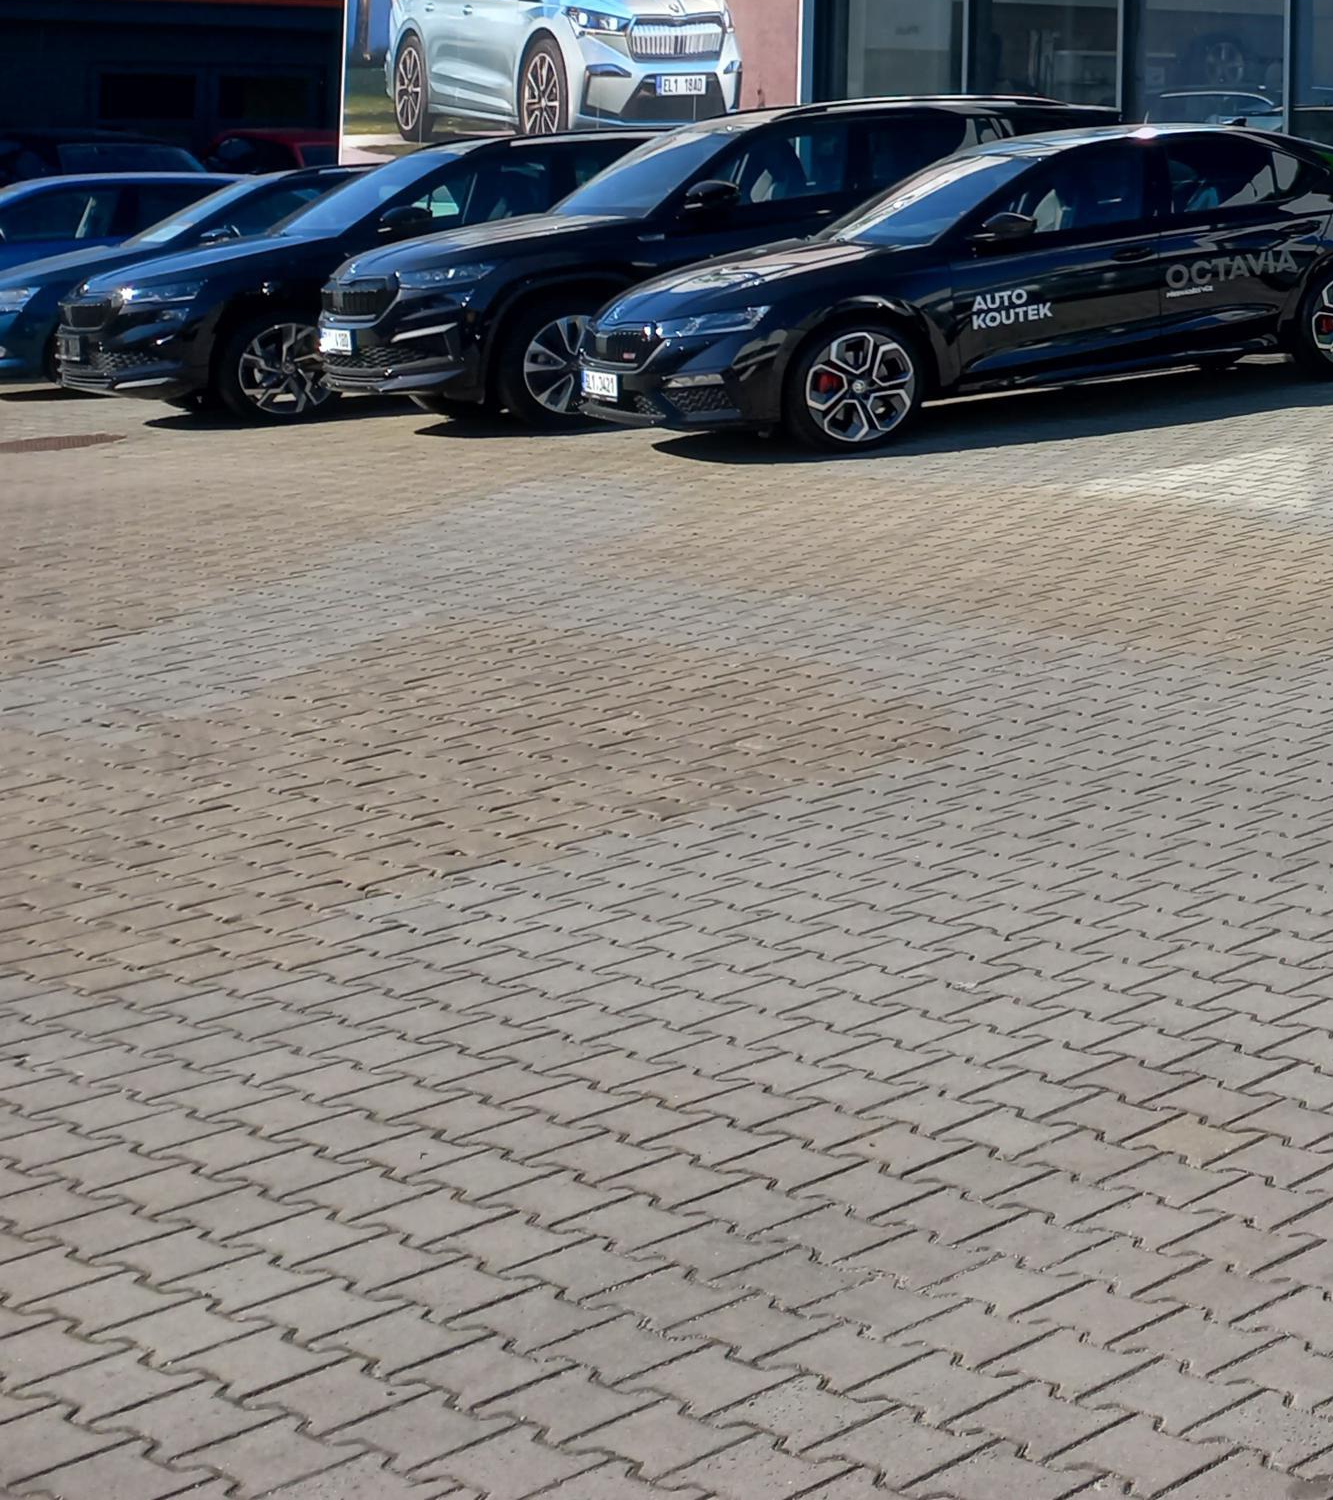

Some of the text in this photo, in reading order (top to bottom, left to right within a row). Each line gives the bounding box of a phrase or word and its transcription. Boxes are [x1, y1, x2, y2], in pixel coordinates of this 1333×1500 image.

[1165, 250, 1298, 288] OCTAVIA
[972, 288, 1027, 312] AUTO
[972, 302, 1052, 330] KOUTEK
